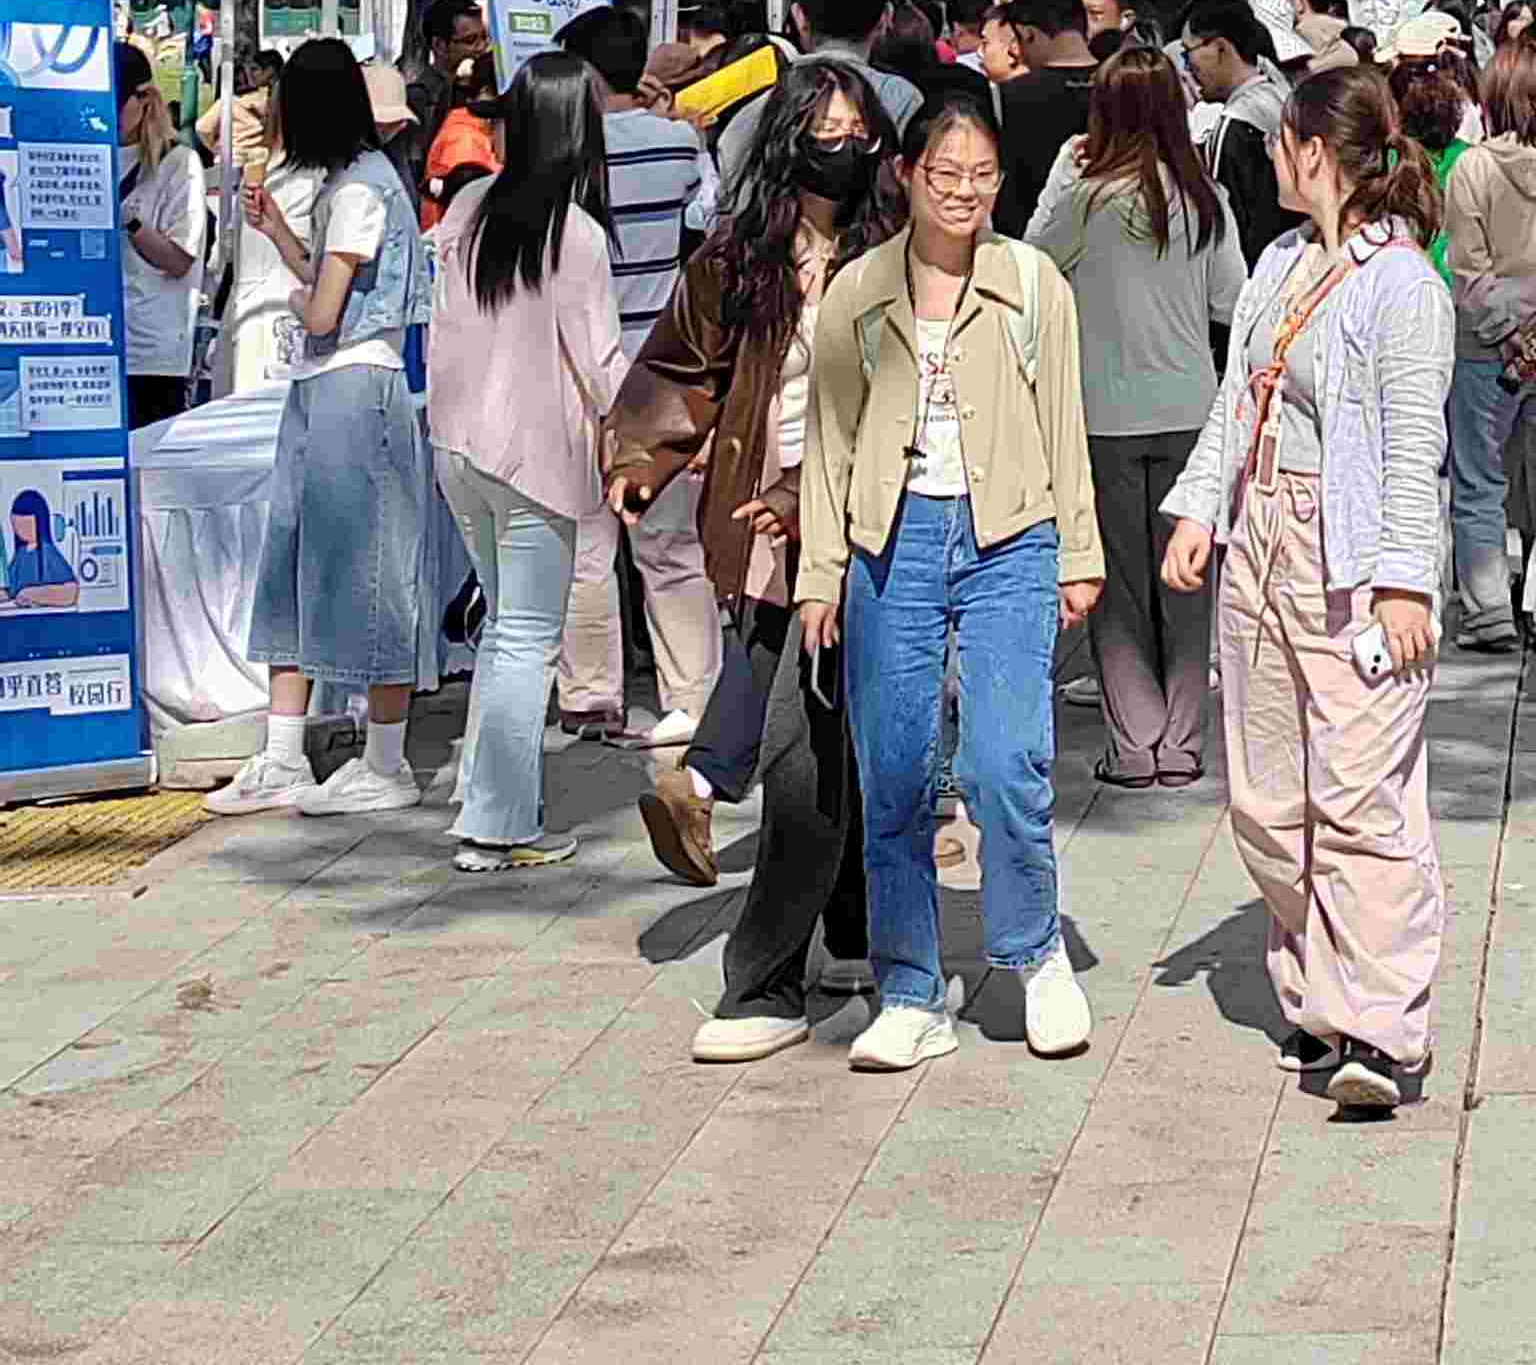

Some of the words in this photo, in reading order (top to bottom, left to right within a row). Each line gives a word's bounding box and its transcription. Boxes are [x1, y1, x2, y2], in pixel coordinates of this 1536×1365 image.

[0, 672, 61, 699] 乎直答
[69, 680, 124, 706] 校园行
